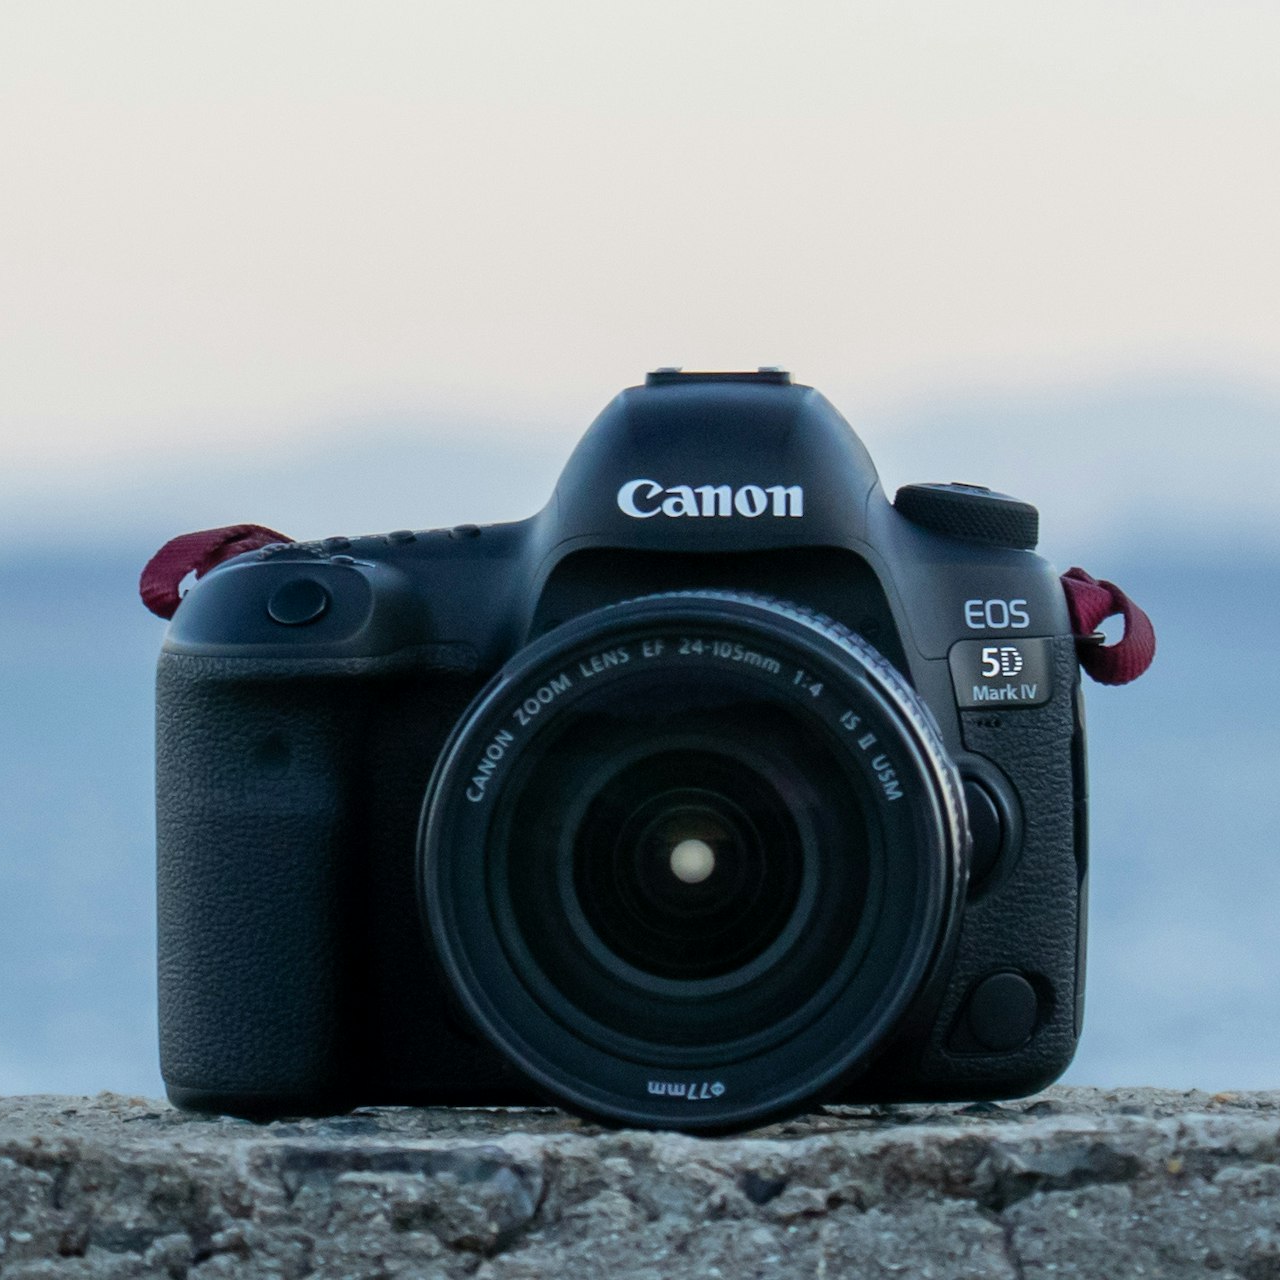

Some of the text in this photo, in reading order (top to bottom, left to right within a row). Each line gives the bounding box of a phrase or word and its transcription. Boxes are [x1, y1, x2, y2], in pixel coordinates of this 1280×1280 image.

[617, 478, 803, 518] Canon
[964, 599, 1030, 629] EOS
[981, 647, 1023, 677] 5D
[973, 684, 1037, 701] Mark IV
[466, 729, 514, 802] CANON
[513, 673, 572, 726] ZOOM
[579, 648, 630, 677] LENS
[642, 640, 664, 658] EF
[678, 638, 781, 674] 24-105mm
[793, 670, 824, 697] 1:4
[839, 710, 861, 730] IS
[871, 754, 904, 802] USM
